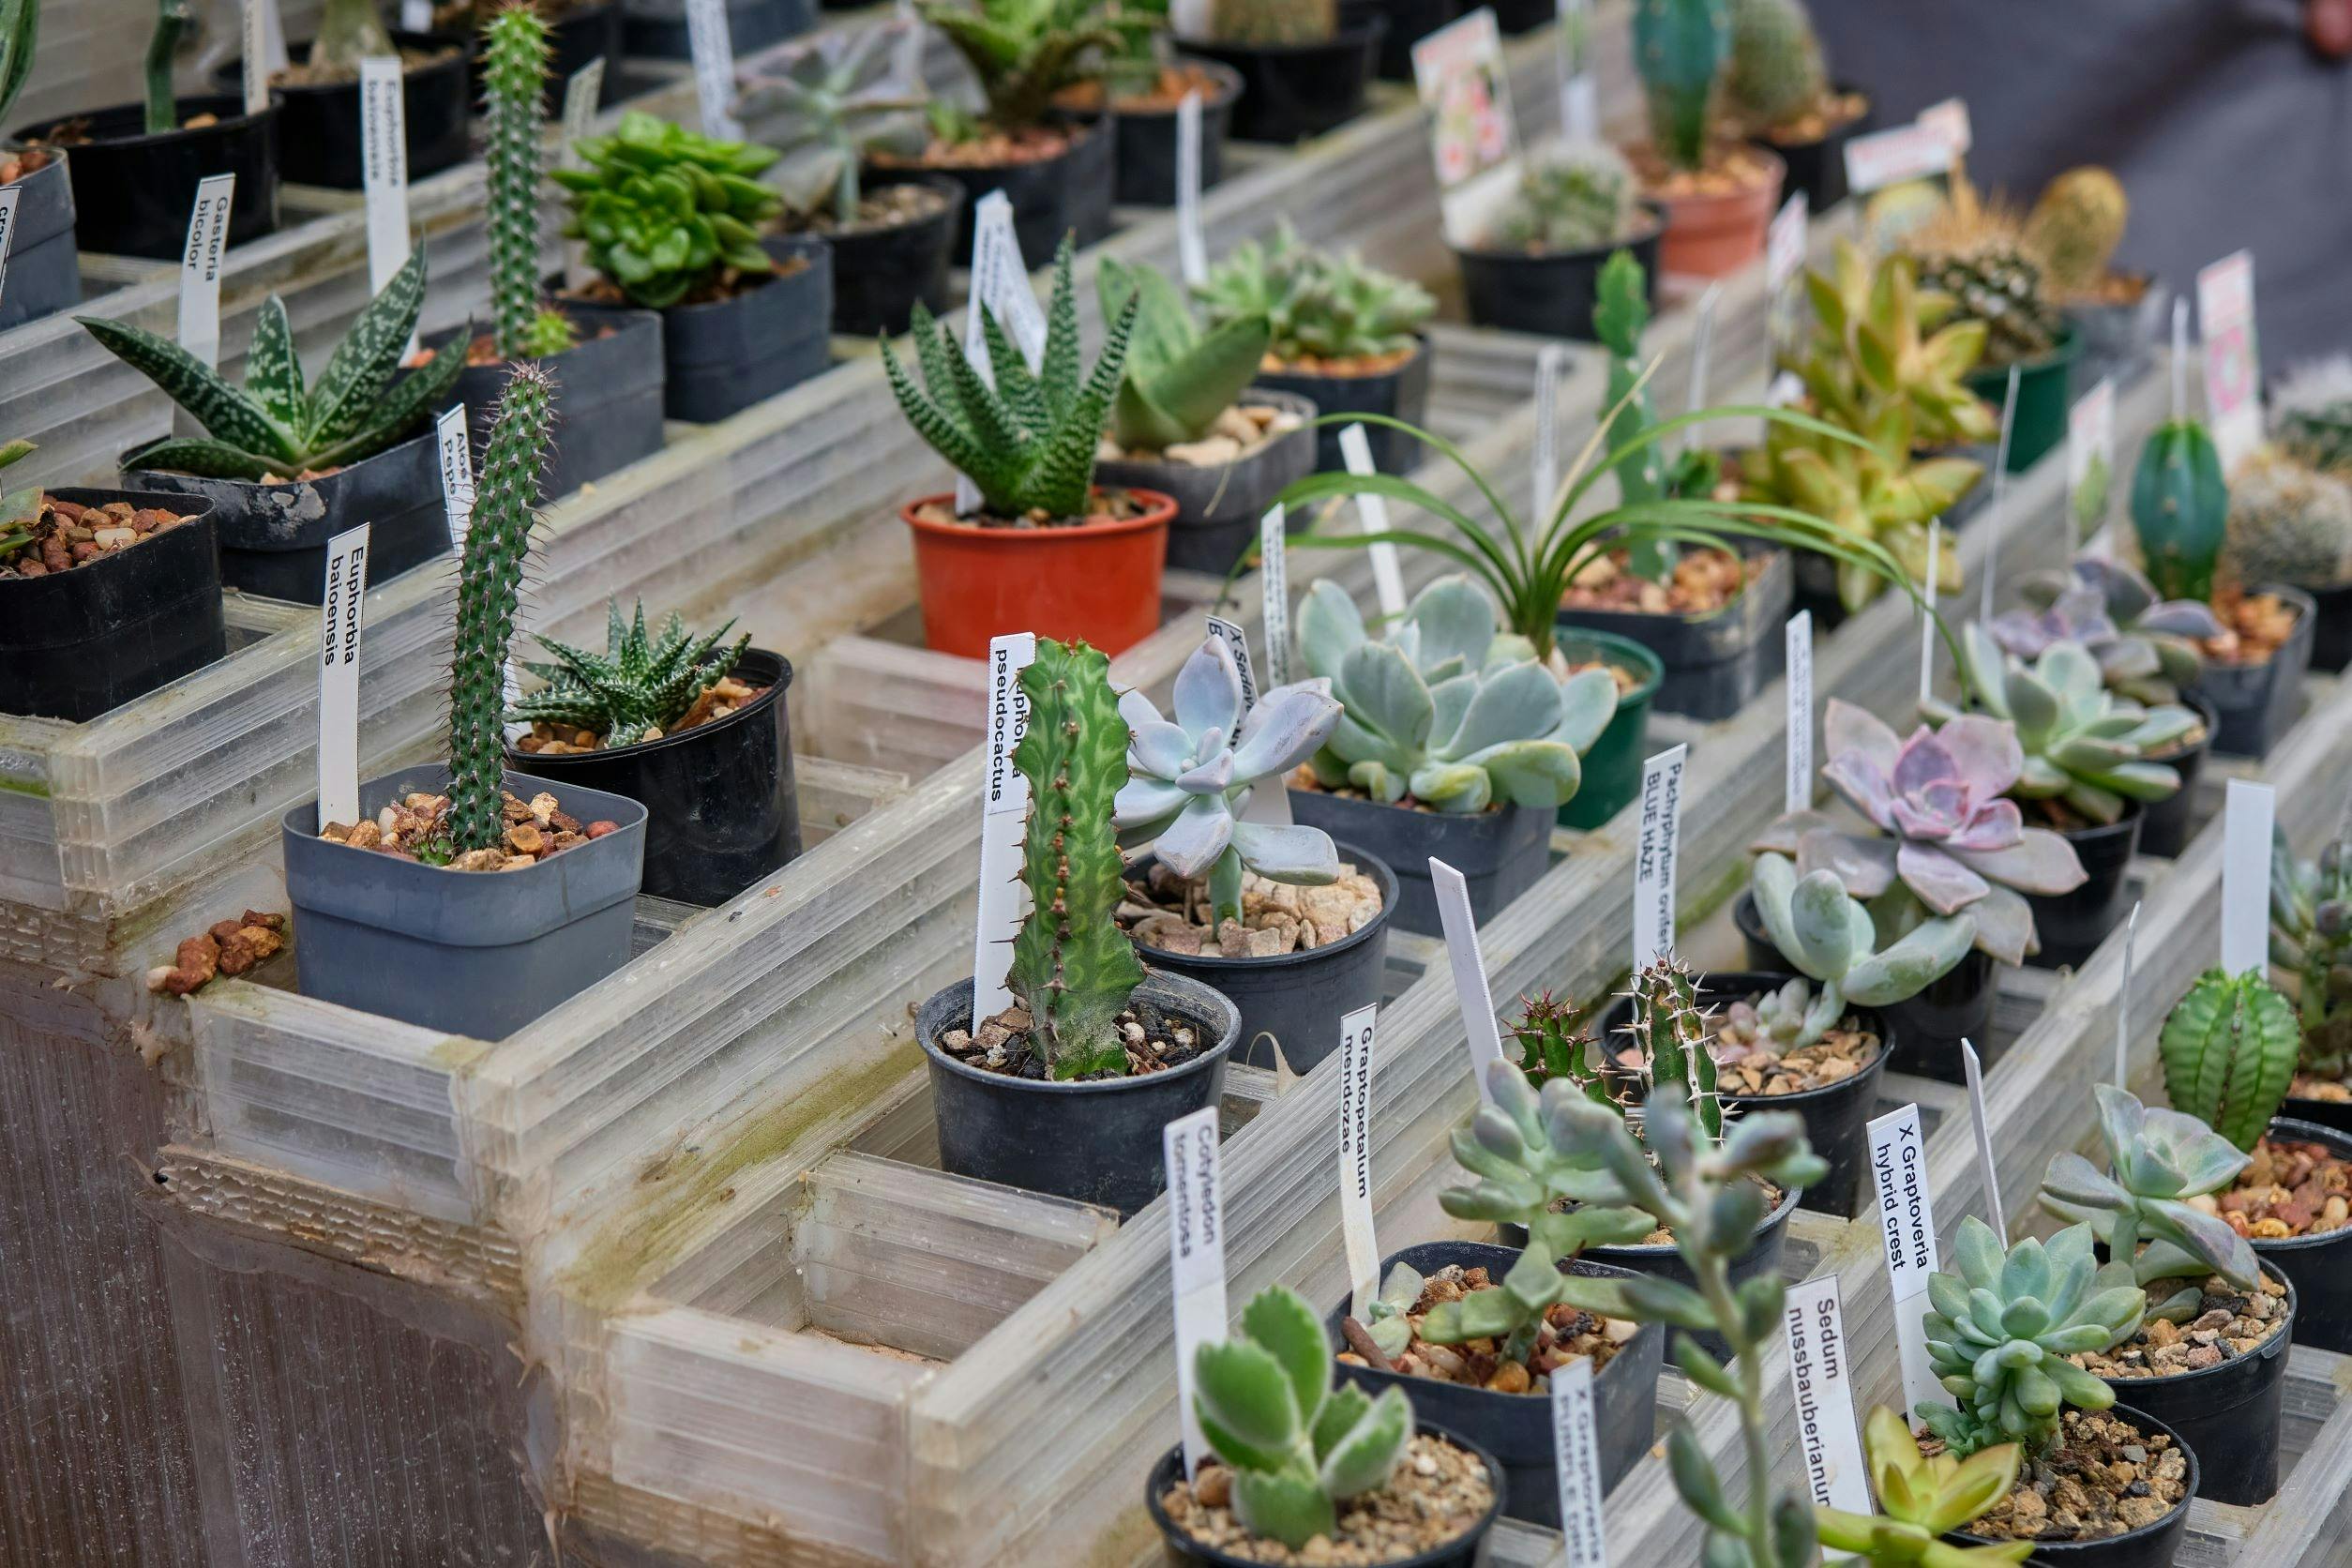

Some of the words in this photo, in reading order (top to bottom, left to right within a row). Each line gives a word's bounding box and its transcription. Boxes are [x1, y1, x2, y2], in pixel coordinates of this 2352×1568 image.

[188, 199, 211, 270] bicolor
[205, 196, 228, 281] Gasteria
[445, 438, 456, 495] Pepe
[324, 554, 344, 667] baioensis
[343, 546, 365, 665] Euphorbia
[1229, 628, 1244, 647] X
[991, 649, 1008, 802] pseudocactus
[1012, 667, 1028, 780] uphora
[1643, 771, 1662, 826] BLUE
[1657, 762, 1682, 890] Pachyphytum
[1639, 828, 1657, 884] HAZE
[1342, 1034, 1353, 1153] mendozae
[1355, 1027, 1373, 1199] Graptopetalum
[1898, 1123, 1914, 1142] X
[1174, 1133, 1191, 1258] tomentosa
[1197, 1125, 1215, 1245] Cotyledon
[1876, 1142, 1899, 1212] hybrid
[1902, 1145, 1929, 1269] Graptoveria
[1886, 1216, 1907, 1272] crest
[1817, 1298, 1839, 1380] Sedum
[1576, 1410, 1600, 1563] Graptoveria
